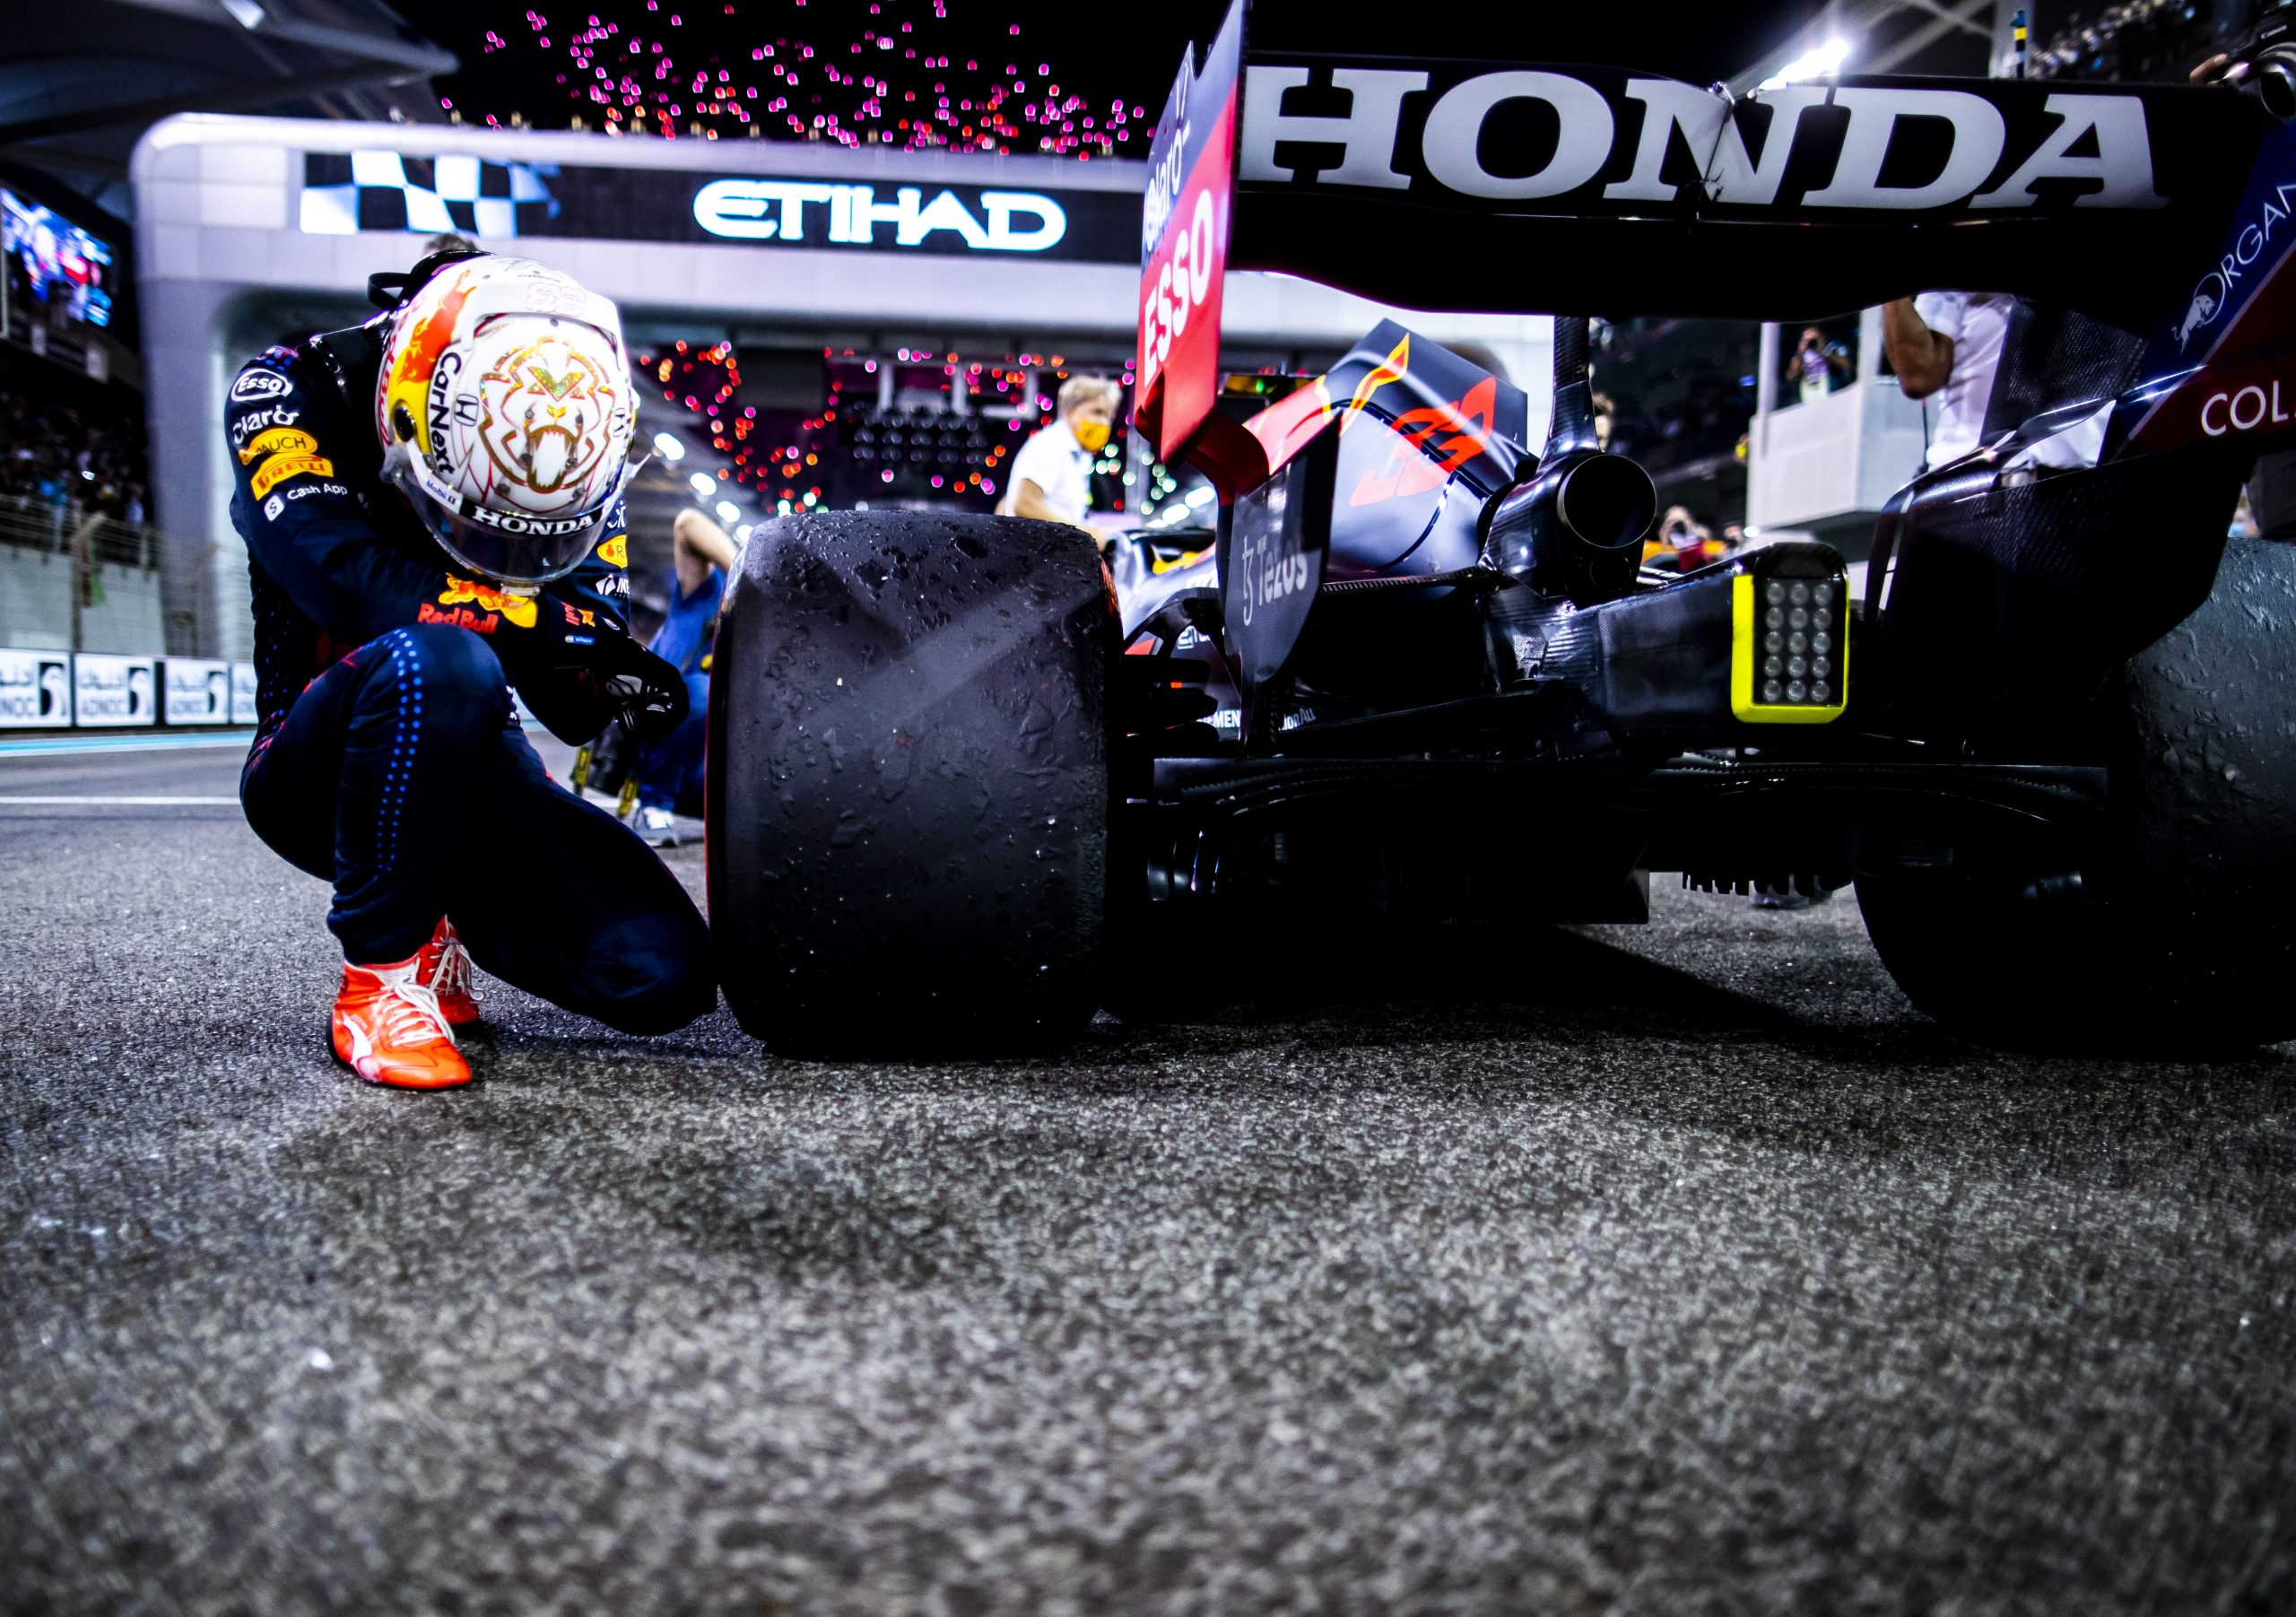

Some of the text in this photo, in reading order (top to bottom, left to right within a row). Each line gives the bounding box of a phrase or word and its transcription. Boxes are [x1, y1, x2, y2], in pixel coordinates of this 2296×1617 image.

[1241, 65, 2169, 209] HONDA
[693, 179, 1067, 251] ETIHAD
[430, 352, 462, 474] CarNext
[2201, 380, 2296, 436] COL
[323, 483, 348, 496] App
[472, 505, 594, 535] HONDA
[418, 603, 499, 634] Red Bull
